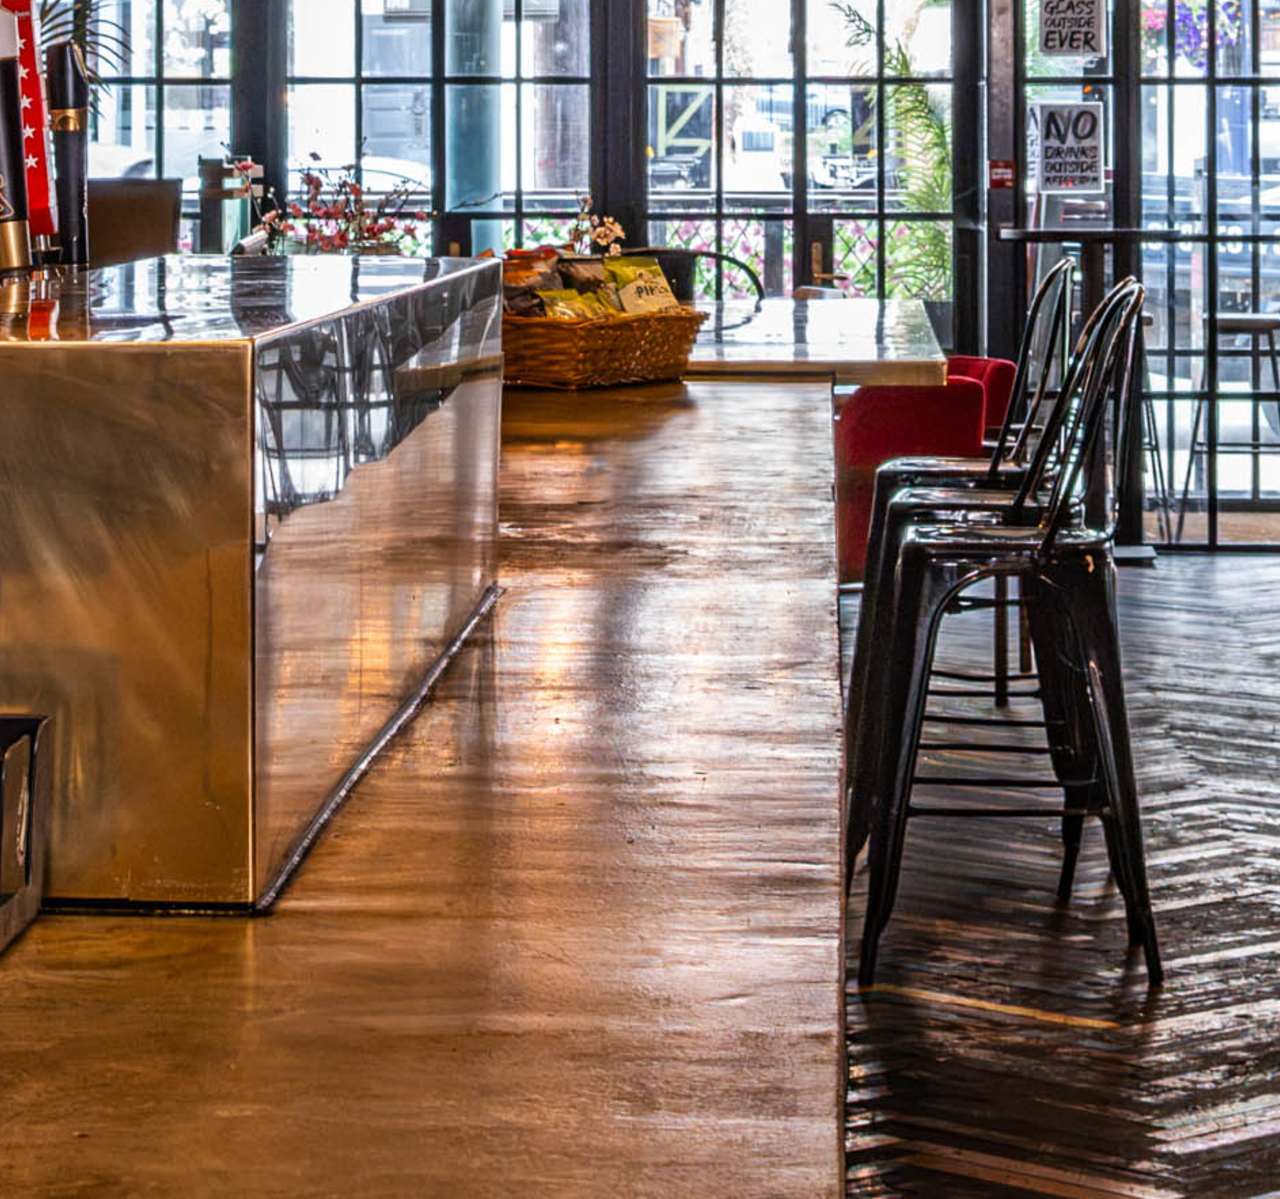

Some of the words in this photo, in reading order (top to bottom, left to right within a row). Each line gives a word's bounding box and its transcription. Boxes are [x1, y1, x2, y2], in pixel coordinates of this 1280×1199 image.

[1044, 0, 1096, 15] GLASS
[1044, 16, 1096, 29] OUTSIDE
[1044, 30, 1097, 52] EVER
[1044, 110, 1097, 144] NO
[1044, 146, 1098, 159] DRINKS
[1044, 160, 1098, 173] OUTSIDE
